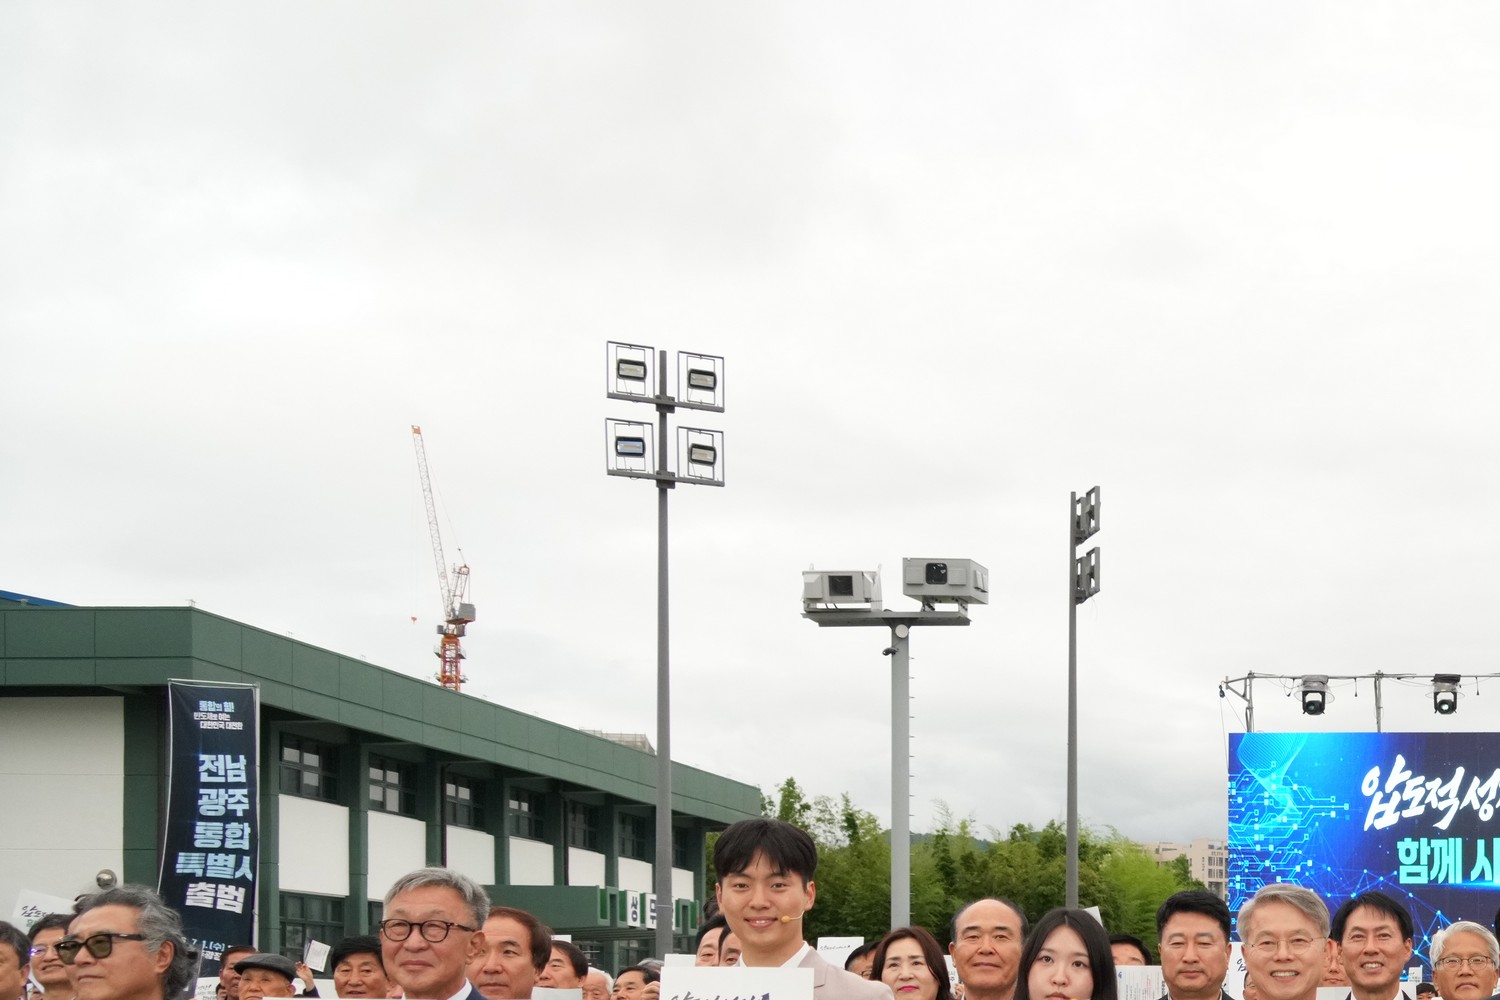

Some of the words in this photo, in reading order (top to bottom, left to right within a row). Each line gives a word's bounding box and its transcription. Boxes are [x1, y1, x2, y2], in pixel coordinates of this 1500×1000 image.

[198, 754, 247, 783] 전남
[197, 788, 250, 817] 광주
[1361, 754, 1465, 831] 압도적
[193, 822, 251, 850] 통합
[1397, 836, 1463, 885] 함께
[185, 882, 246, 915] 출범
